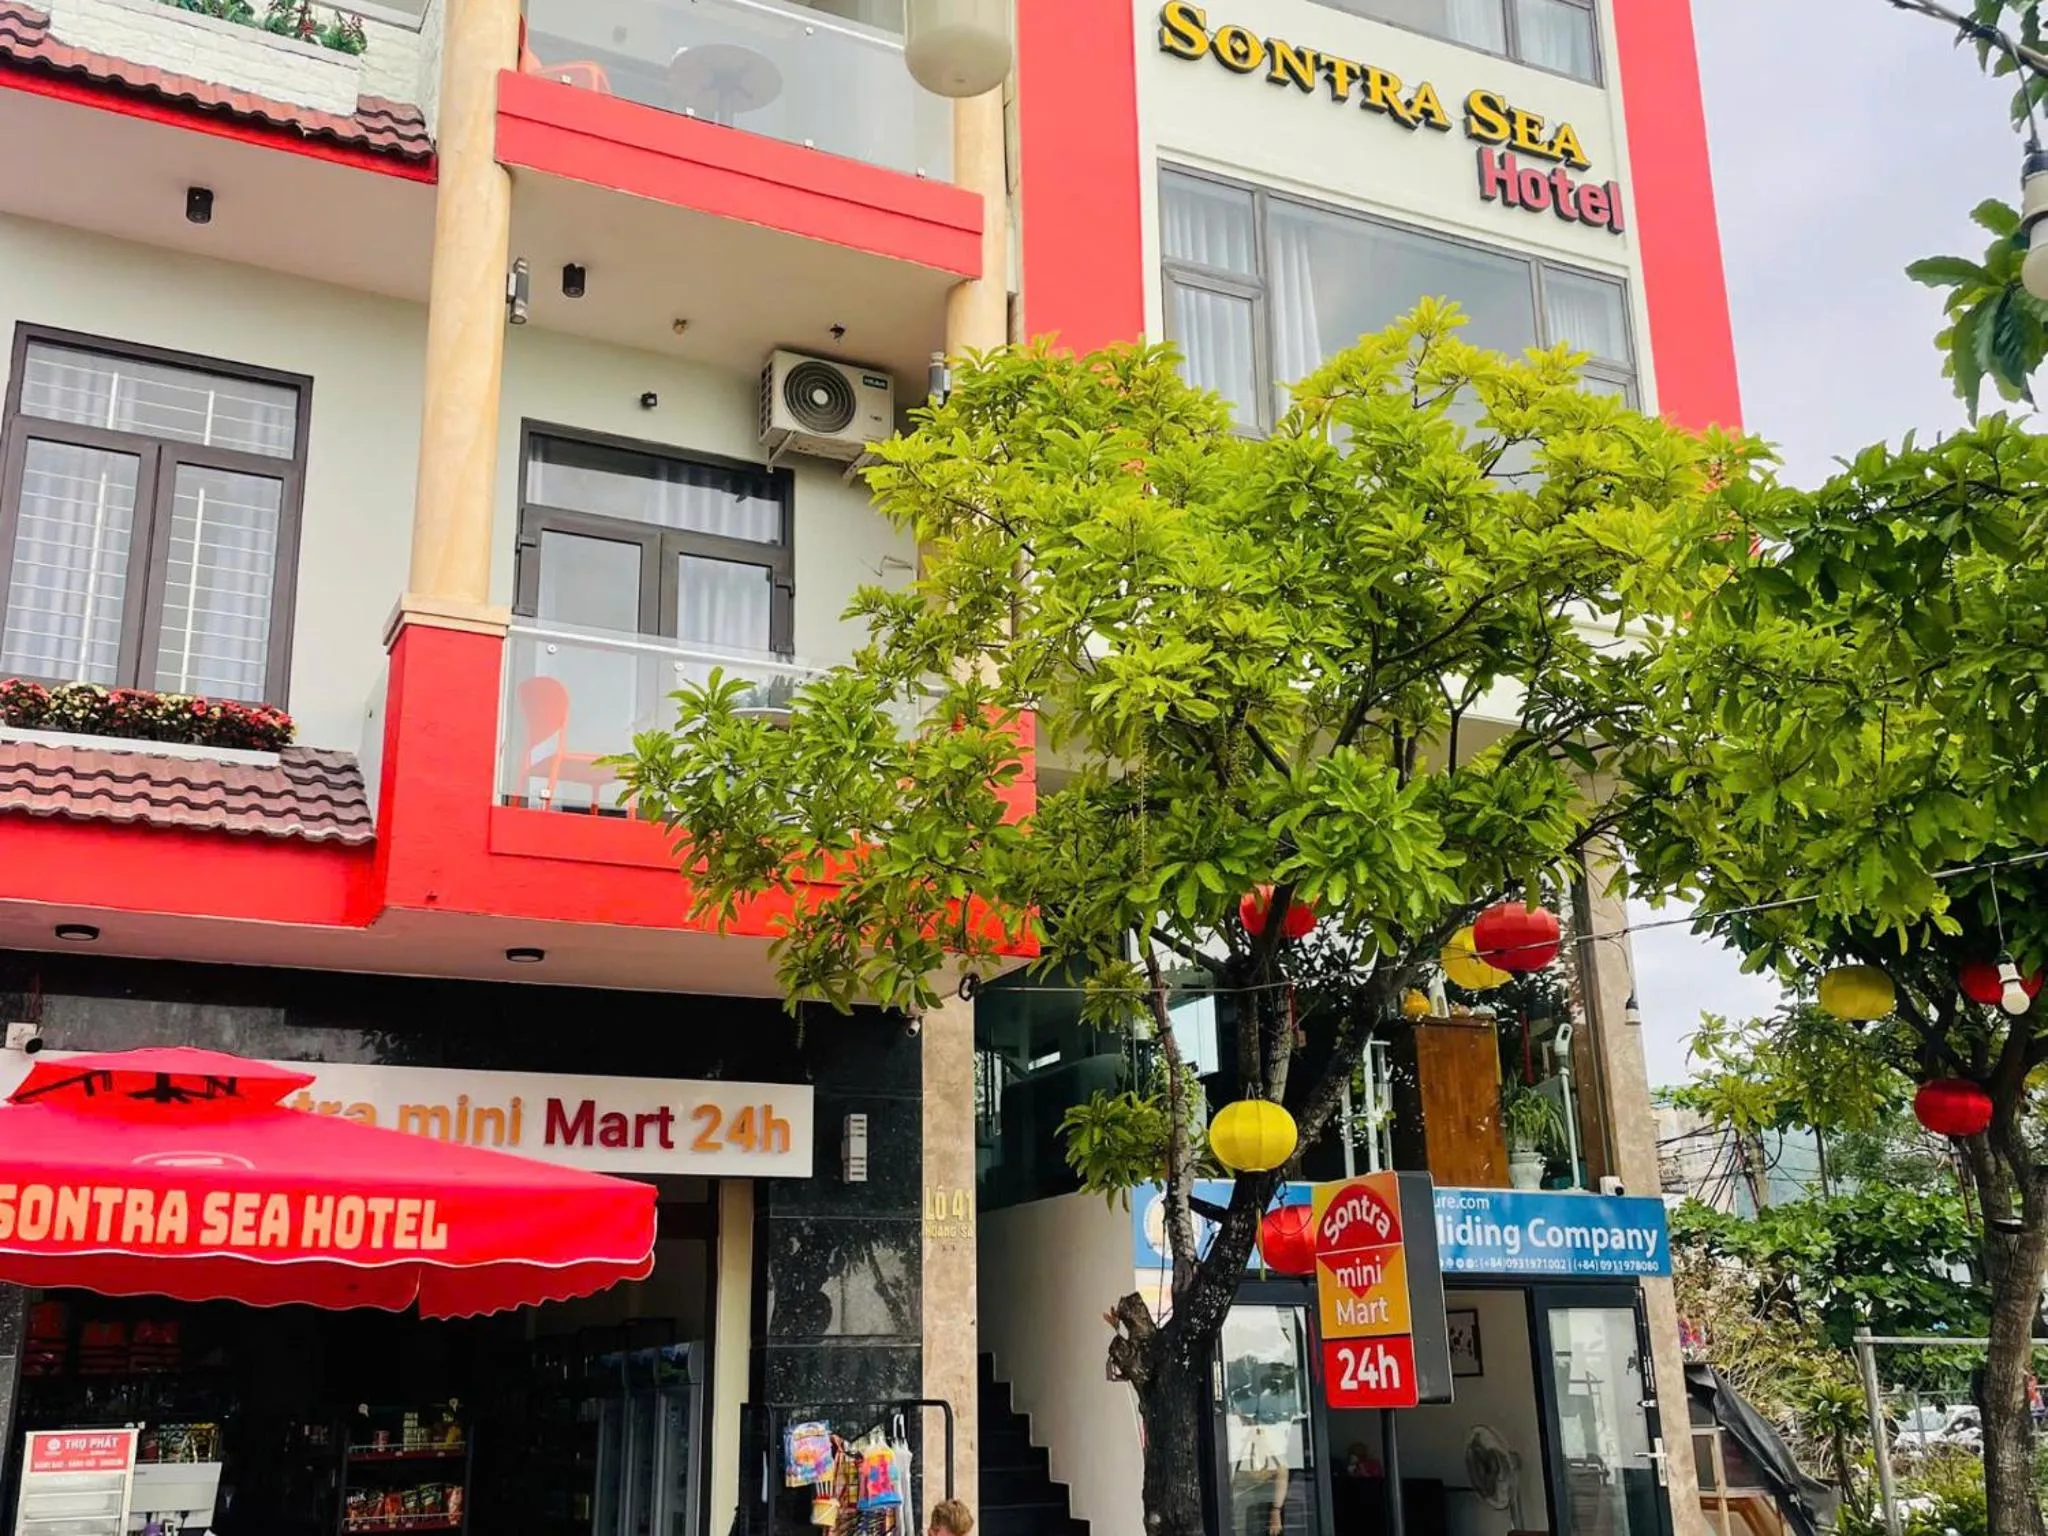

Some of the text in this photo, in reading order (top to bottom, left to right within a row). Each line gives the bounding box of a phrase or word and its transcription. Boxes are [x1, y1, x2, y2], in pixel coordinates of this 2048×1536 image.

[1159, 0, 1592, 171] SONTRA SEA
[1477, 147, 1624, 234] Hotel
[397, 1094, 522, 1146] mini
[544, 1098, 675, 1149] Mart
[690, 1103, 792, 1153] 24h
[200, 1191, 291, 1248] SEA
[299, 1195, 448, 1250] HOTEL
[952, 1187, 974, 1221] 41
[1323, 1194, 1391, 1246] Sontra
[1434, 1195, 1490, 1210] ure.com
[1436, 1214, 1659, 1257] liding Company
[1336, 1255, 1383, 1288] mini
[1335, 1298, 1389, 1326] Mart
[1336, 1344, 1401, 1391] 24h
